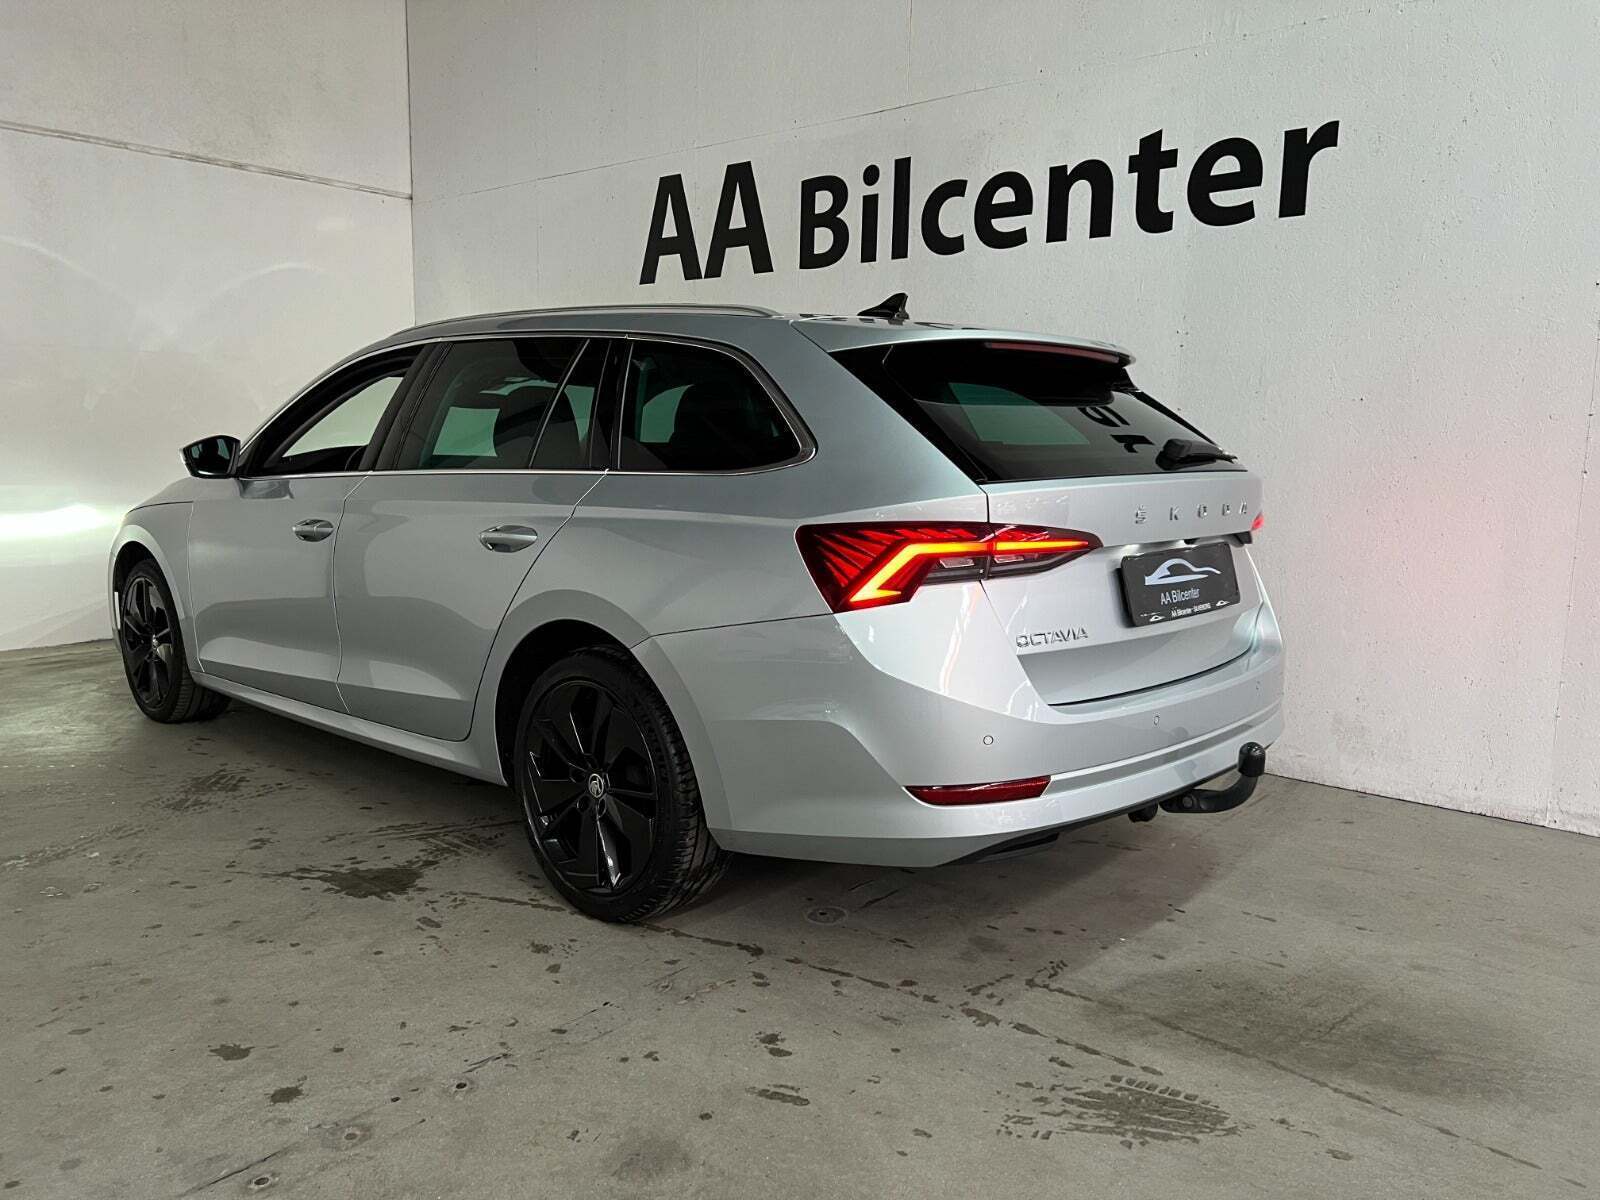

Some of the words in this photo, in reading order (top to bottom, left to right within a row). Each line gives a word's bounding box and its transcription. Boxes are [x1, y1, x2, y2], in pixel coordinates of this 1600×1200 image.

[639, 161, 773, 285] AA
[799, 120, 1339, 269] Bilcenter
[1160, 591, 1172, 605] AA
[1172, 588, 1200, 602] Bilcenter
[1016, 627, 1088, 647] OCTAVIA
